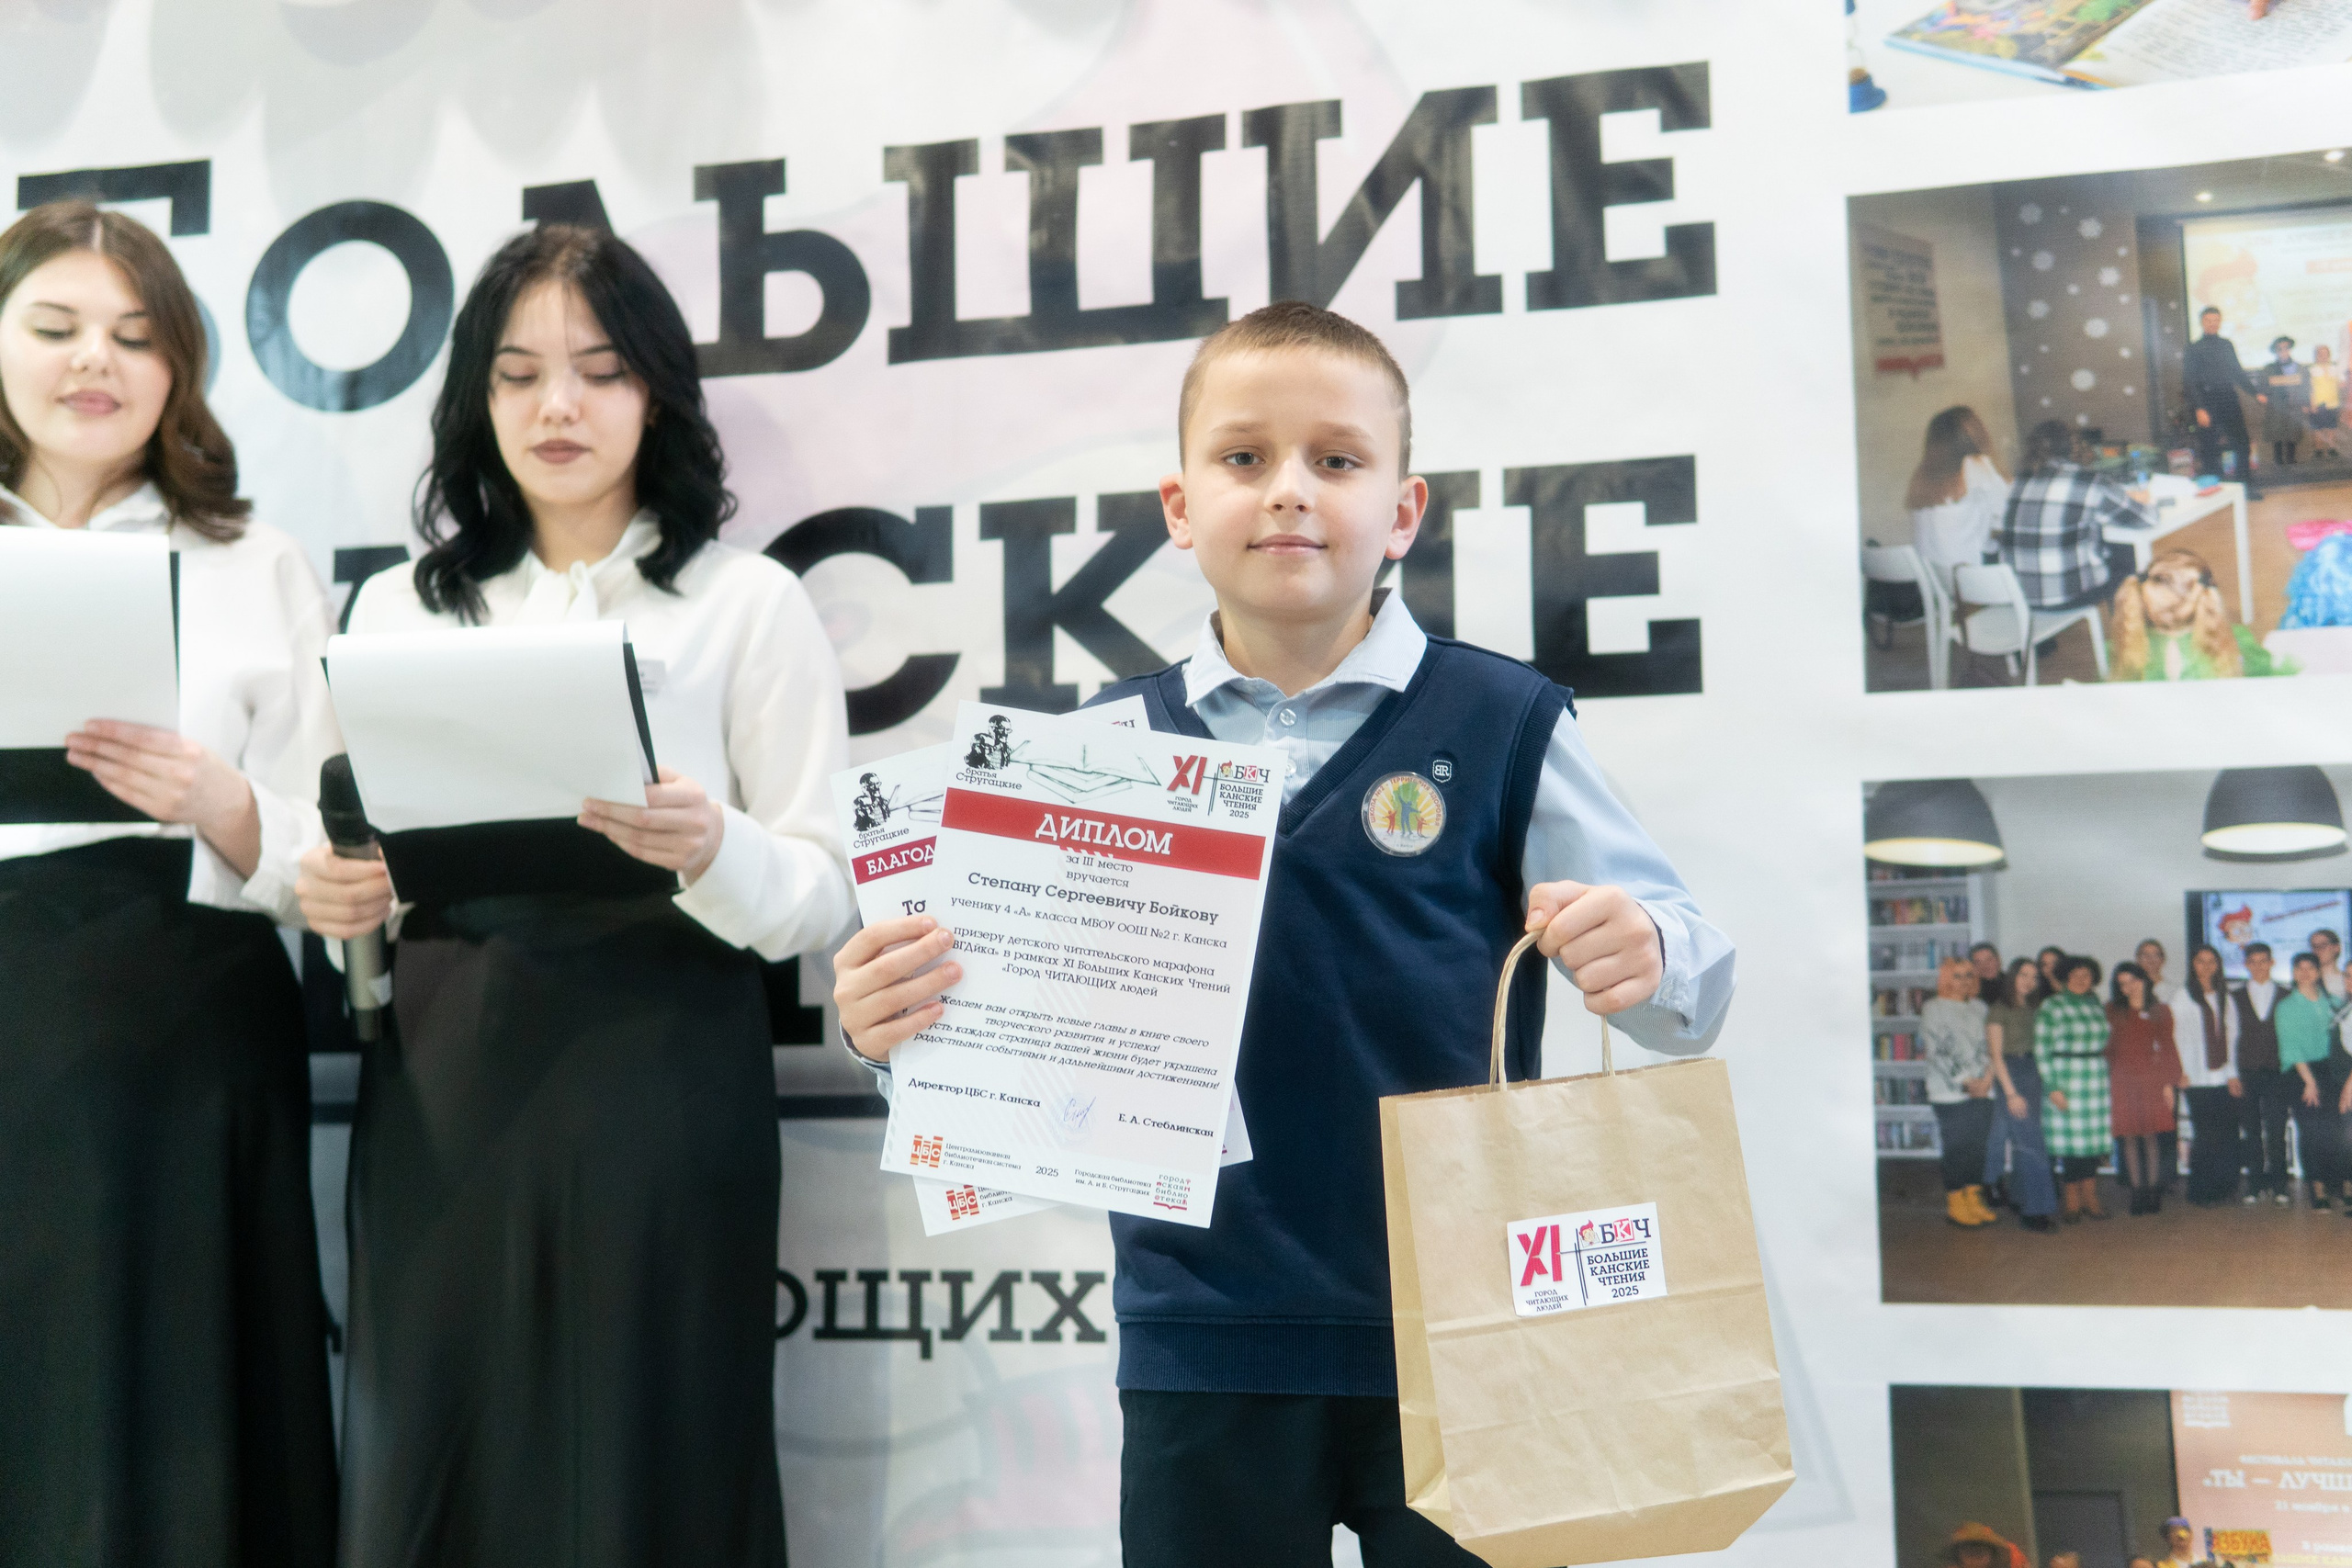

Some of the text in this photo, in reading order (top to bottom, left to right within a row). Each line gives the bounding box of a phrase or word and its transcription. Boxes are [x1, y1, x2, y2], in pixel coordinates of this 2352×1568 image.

[956, 773, 1023, 791] Стругацкие
[965, 767, 998, 779] братья
[1167, 755, 1207, 795] XI
[1219, 783, 1263, 795] БОЛЬШИЕ
[1219, 791, 1262, 803] КАНСКИЕ
[1223, 799, 1257, 810] ЧТЕНИЯ
[1228, 808, 1249, 818] 2025
[1369, 798, 1377, 823] ШКОЛА
[854, 828, 910, 849] Стругацкие
[858, 828, 886, 840] братья
[1035, 813, 1173, 855] ДИПЛОМ
[866, 844, 935, 876] БЛАГОД
[1065, 855, 1133, 873] за III место
[1066, 870, 1129, 887] вручается
[967, 872, 1219, 925] Степану Сергеевичу Бойкову
[951, 897, 1227, 948] ученику 4 «А» класса МБОУ ООШ №2 г. Канска
[954, 926, 1215, 976] призеру детского читательского марафона
[1002, 949, 1011, 957] в
[1013, 951, 1059, 965] рамках
[1061, 957, 1075, 968] XI
[1077, 960, 1130, 977] Больших
[1133, 968, 1184, 986] Канских
[1188, 977, 1230, 993] Чтений
[1045, 969, 1117, 989] ЧИТАЮЩИХ
[1119, 983, 1158, 997] людей
[938, 994, 982, 1010] Желаем
[984, 1004, 1007, 1013] вам
[1008, 1008, 1053, 1021] открыть
[1056, 1016, 1091, 1028] новые
[1092, 1021, 1127, 1033] главы
[1138, 1030, 1170, 1041] книге
[1172, 1035, 1209, 1047] своего
[985, 1017, 1052, 1034] творческого
[1052, 1029, 1105, 1043] развития
[1117, 1040, 1160, 1053] успеха!
[928, 1021, 1217, 1076] усть каждая страница вашей жизни будет украшена
[912, 1032, 983, 1049] радостными
[985, 1044, 1046, 1060] событиями
[1057, 1056, 1135, 1075] дальнейшими
[1136, 1070, 1220, 1089] достижениями!
[908, 1077, 963, 1095] Директор
[965, 1087, 988, 1098] ЦБС
[999, 1092, 1040, 1107] Канска
[1118, 1112, 1214, 1137] Е. А. Стеблинская
[911, 1144, 942, 1159] ЦБС
[944, 1150, 1021, 1169] библиотечная система
[945, 1143, 1011, 1159] Централизованная
[949, 1159, 974, 1169] Канска
[1035, 1165, 1058, 1177] 2025
[1074, 1168, 1151, 1188] Городская библиотека
[1108, 1183, 1149, 1196] Стругацких
[948, 1195, 977, 1210] ЦБС
[988, 1197, 1013, 1207] Канска
[1517, 1224, 1563, 1287] XI
[1587, 1247, 1648, 1265] БОЛЬШИЕ
[1589, 1259, 1650, 1276] КАНСКИЕ
[1598, 1271, 1645, 1287] ЧТЕНИЯ
[1526, 1294, 1569, 1306] ЧИТАЮЩИХ
[1534, 1289, 1558, 1298] ГОРОД
[1611, 1285, 1639, 1298] 2025
[1536, 1303, 1563, 1312] ЛЮДЕЙ
[2278, 1472, 2352, 1491] ЛУЧШ
